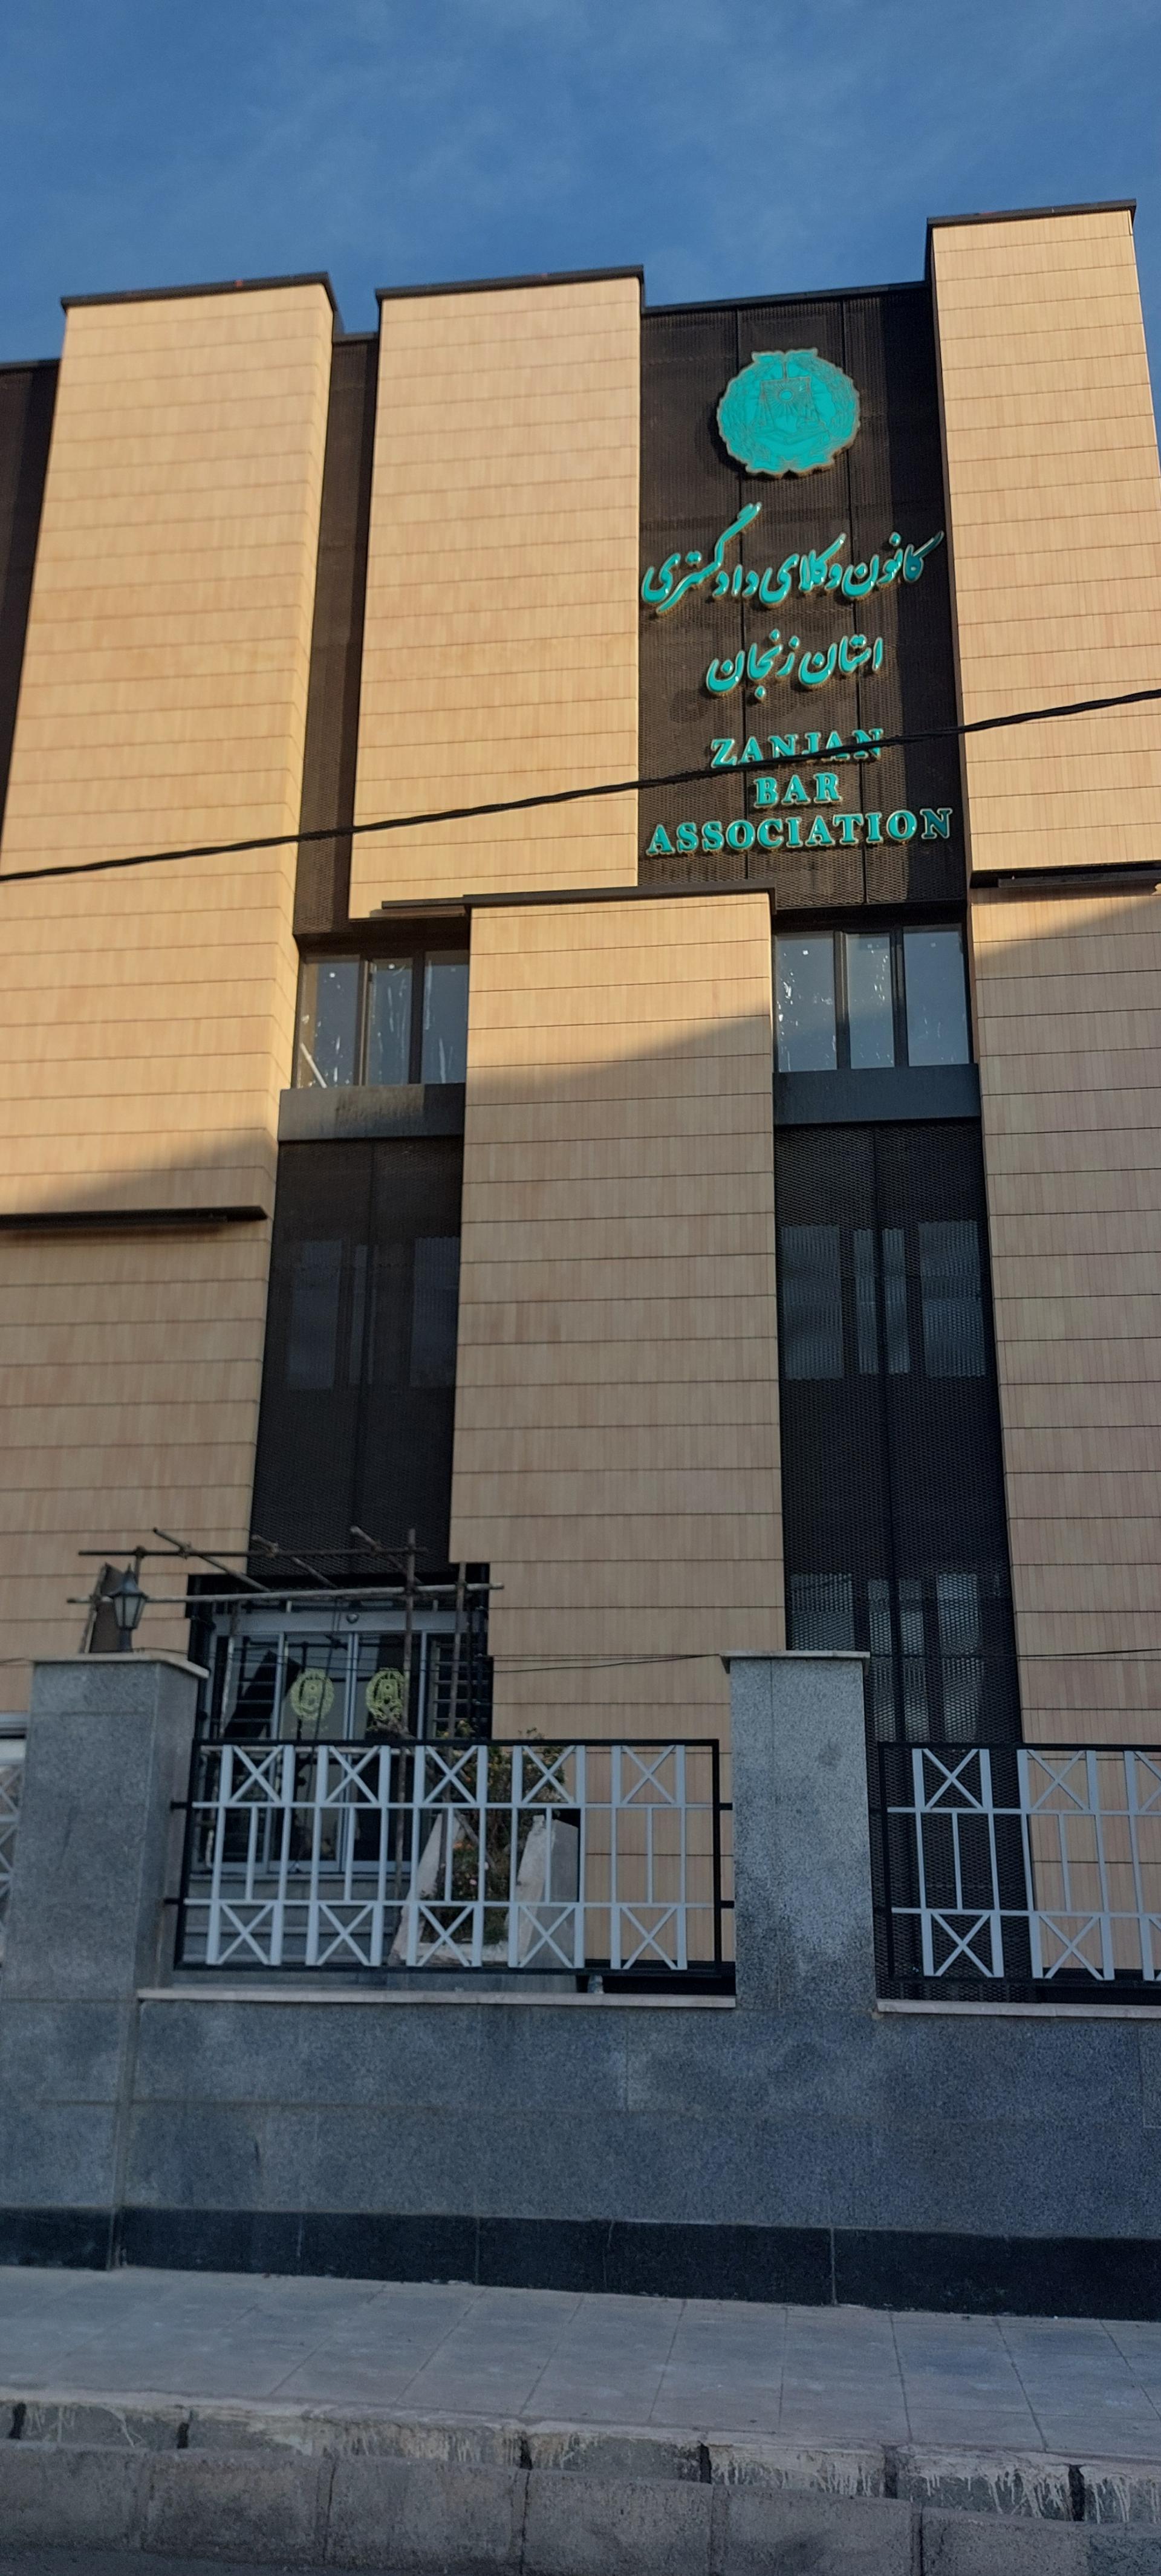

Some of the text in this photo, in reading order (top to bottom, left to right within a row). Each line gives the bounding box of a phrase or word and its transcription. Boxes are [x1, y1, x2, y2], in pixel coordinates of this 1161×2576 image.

[642, 502, 945, 614] کانون وکلای دادگستری
[706, 628, 883, 699] استان زنجان
[710, 728, 883, 768] ZANJAN
[754, 772, 842, 808] BAR
[646, 808, 952, 856] ASSOCIATION
